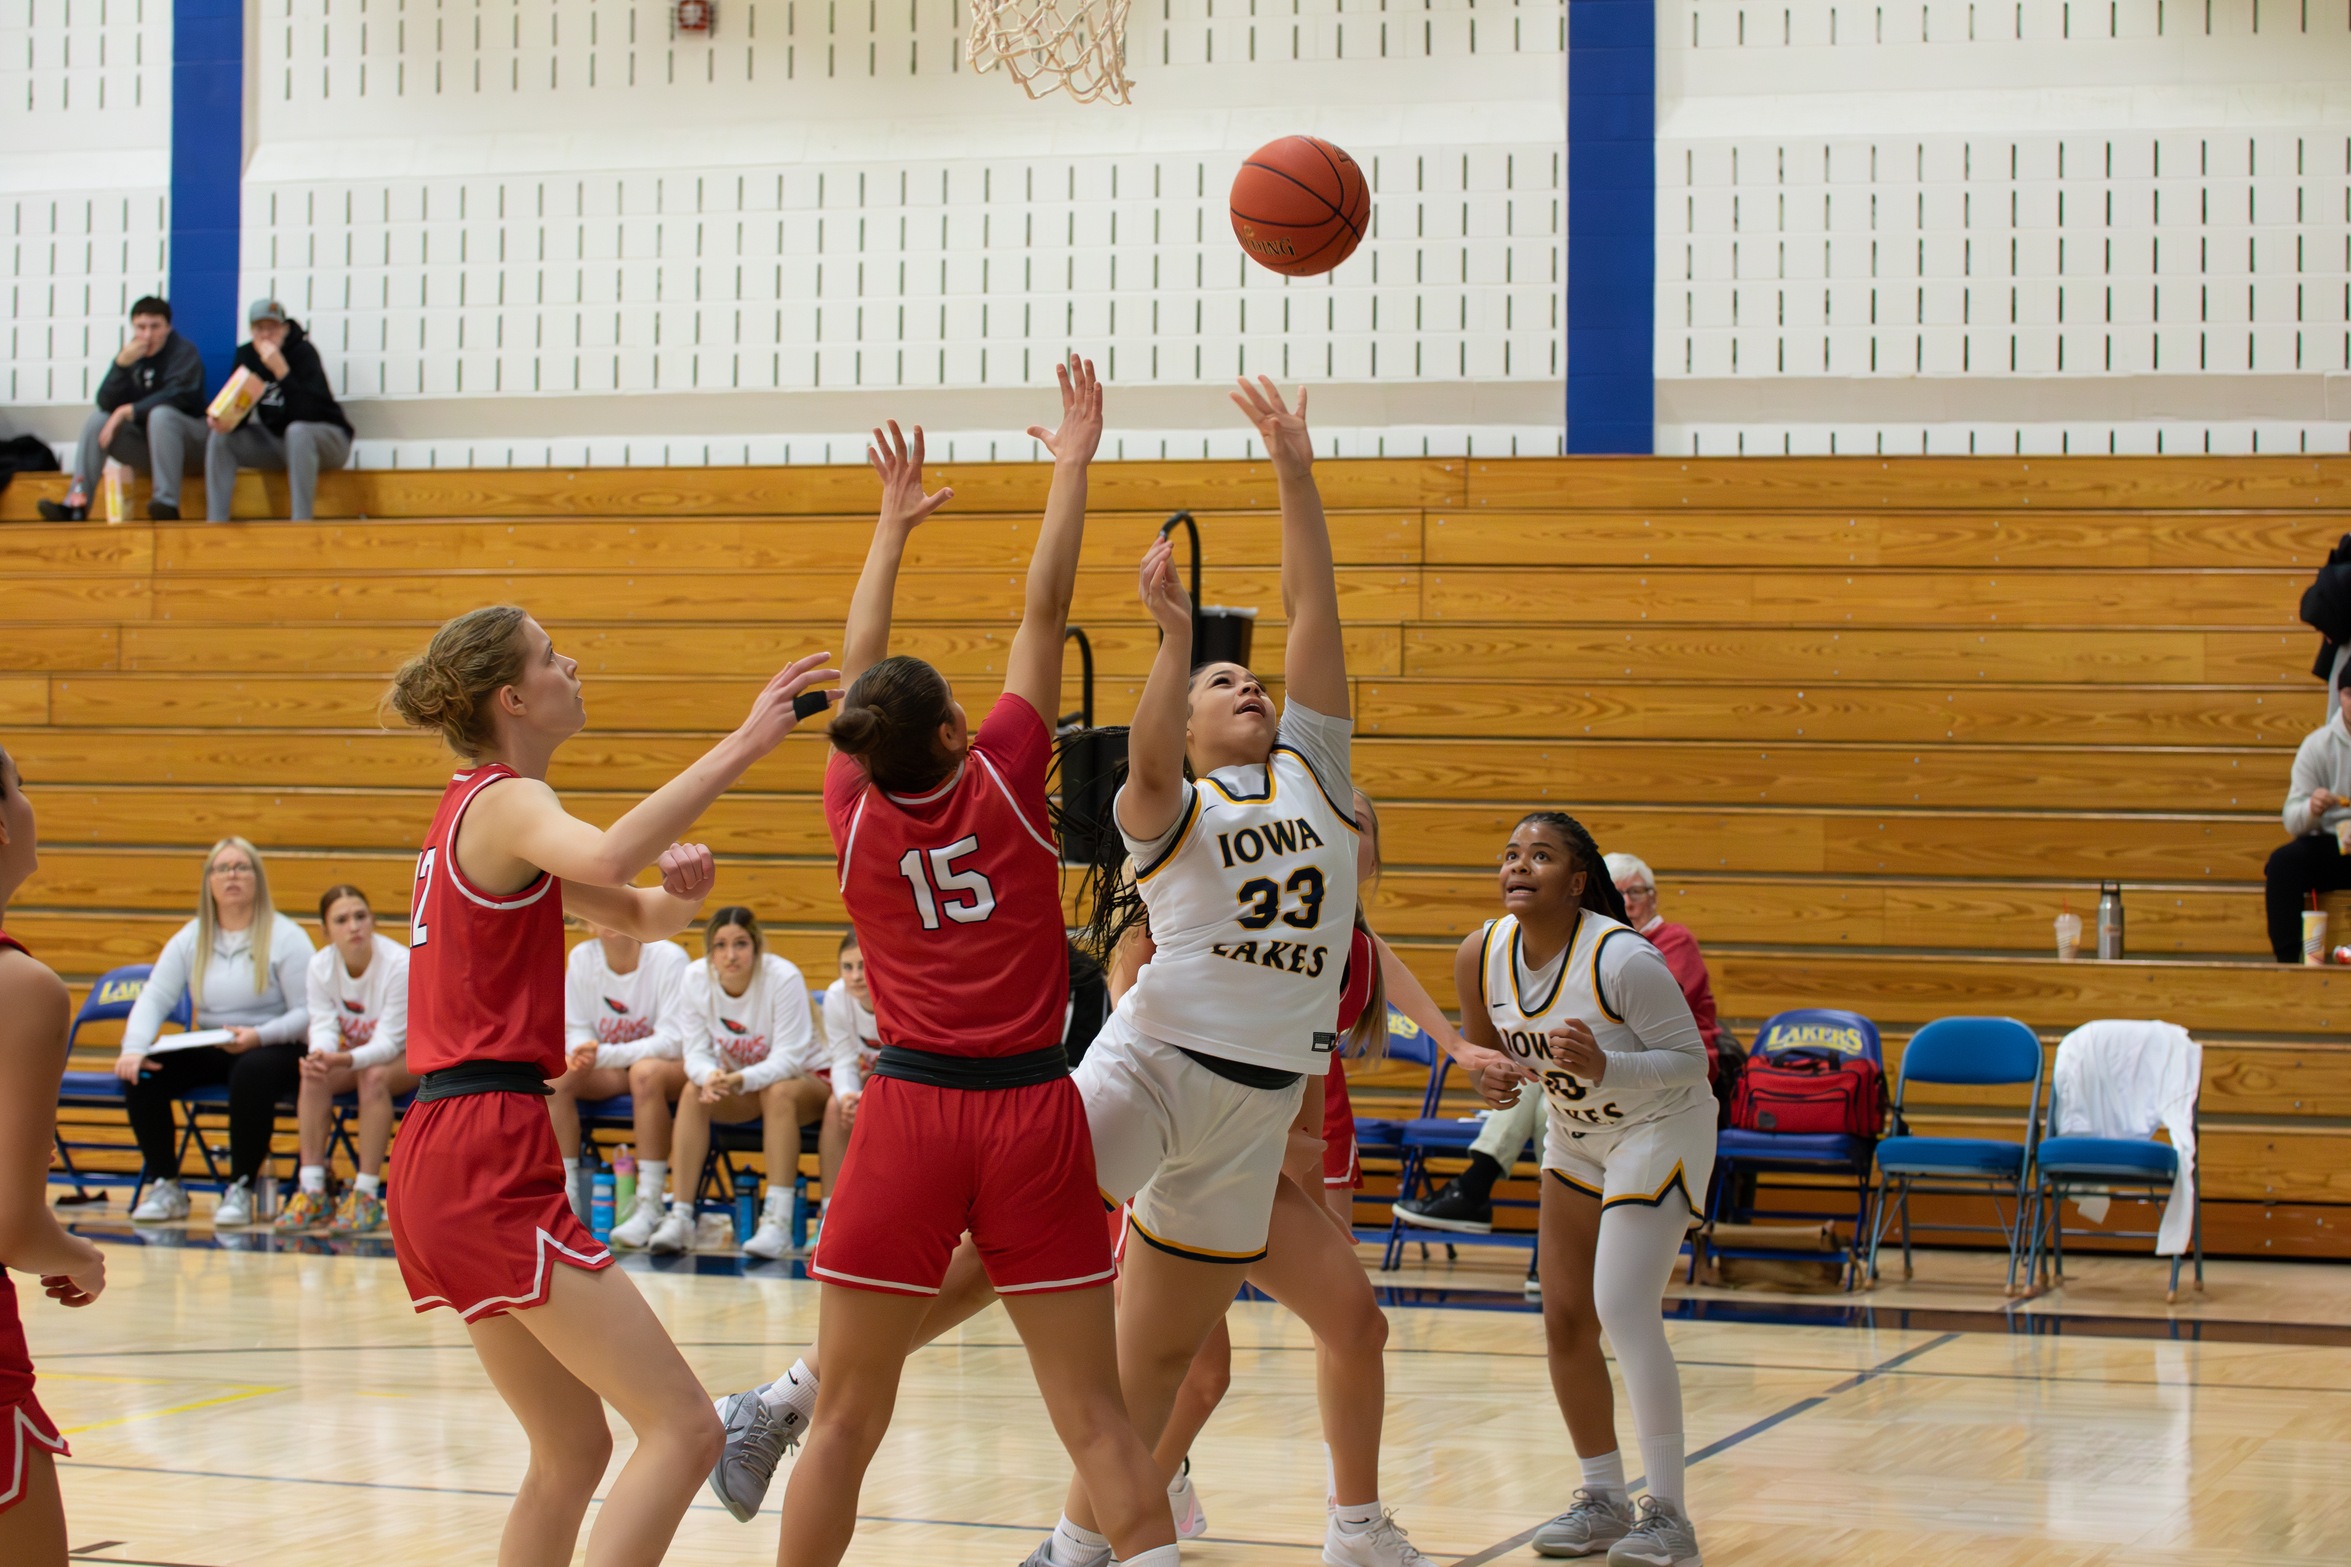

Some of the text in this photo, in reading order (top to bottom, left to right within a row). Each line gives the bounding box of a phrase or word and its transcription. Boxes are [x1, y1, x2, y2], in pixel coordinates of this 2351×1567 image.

[1217, 818, 1325, 869] IOWA
[898, 832, 996, 931] 15
[1235, 864, 1327, 931] 33
[1765, 1023, 1863, 1056] LAKERS
